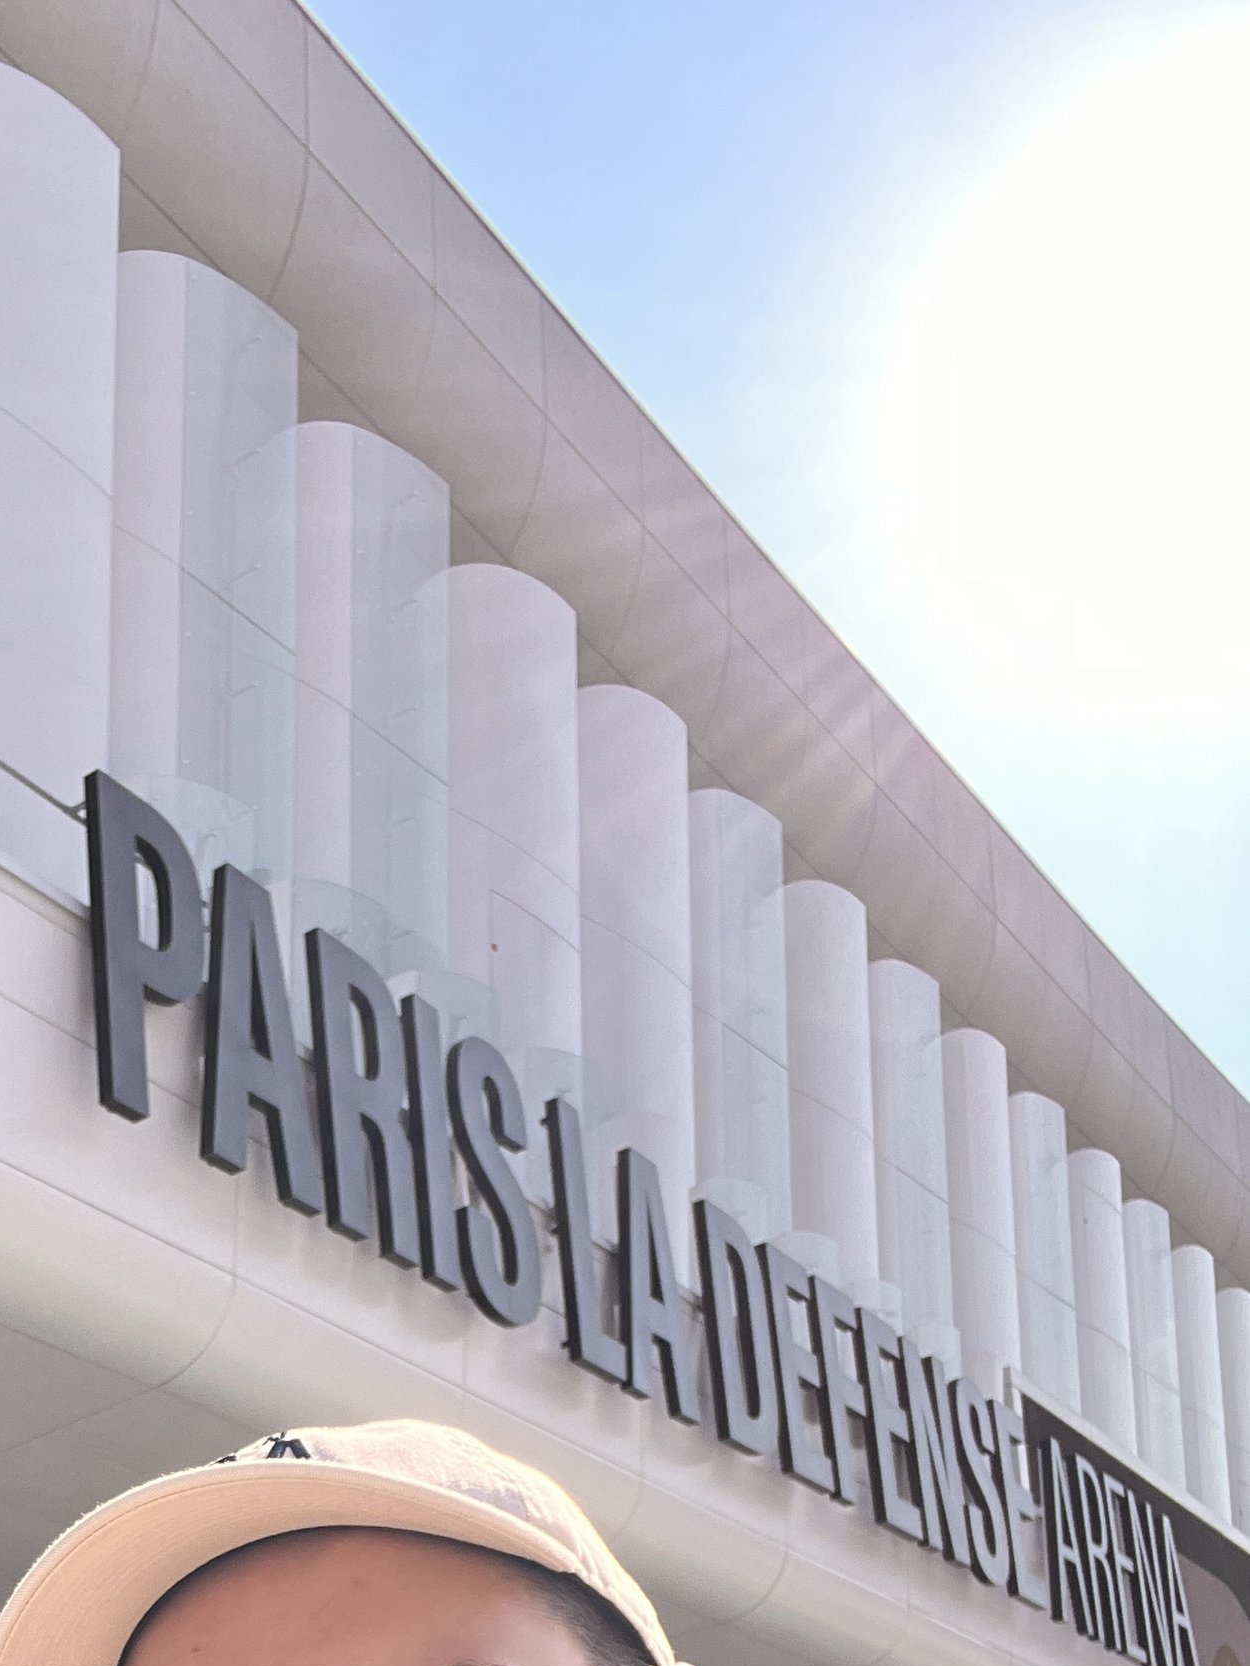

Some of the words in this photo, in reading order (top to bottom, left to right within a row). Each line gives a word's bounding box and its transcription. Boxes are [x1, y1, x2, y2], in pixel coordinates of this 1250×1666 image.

[84, 769, 543, 1329] PARIS
[546, 1098, 700, 1427] LA
[693, 1199, 1048, 1611] DEFENSE
